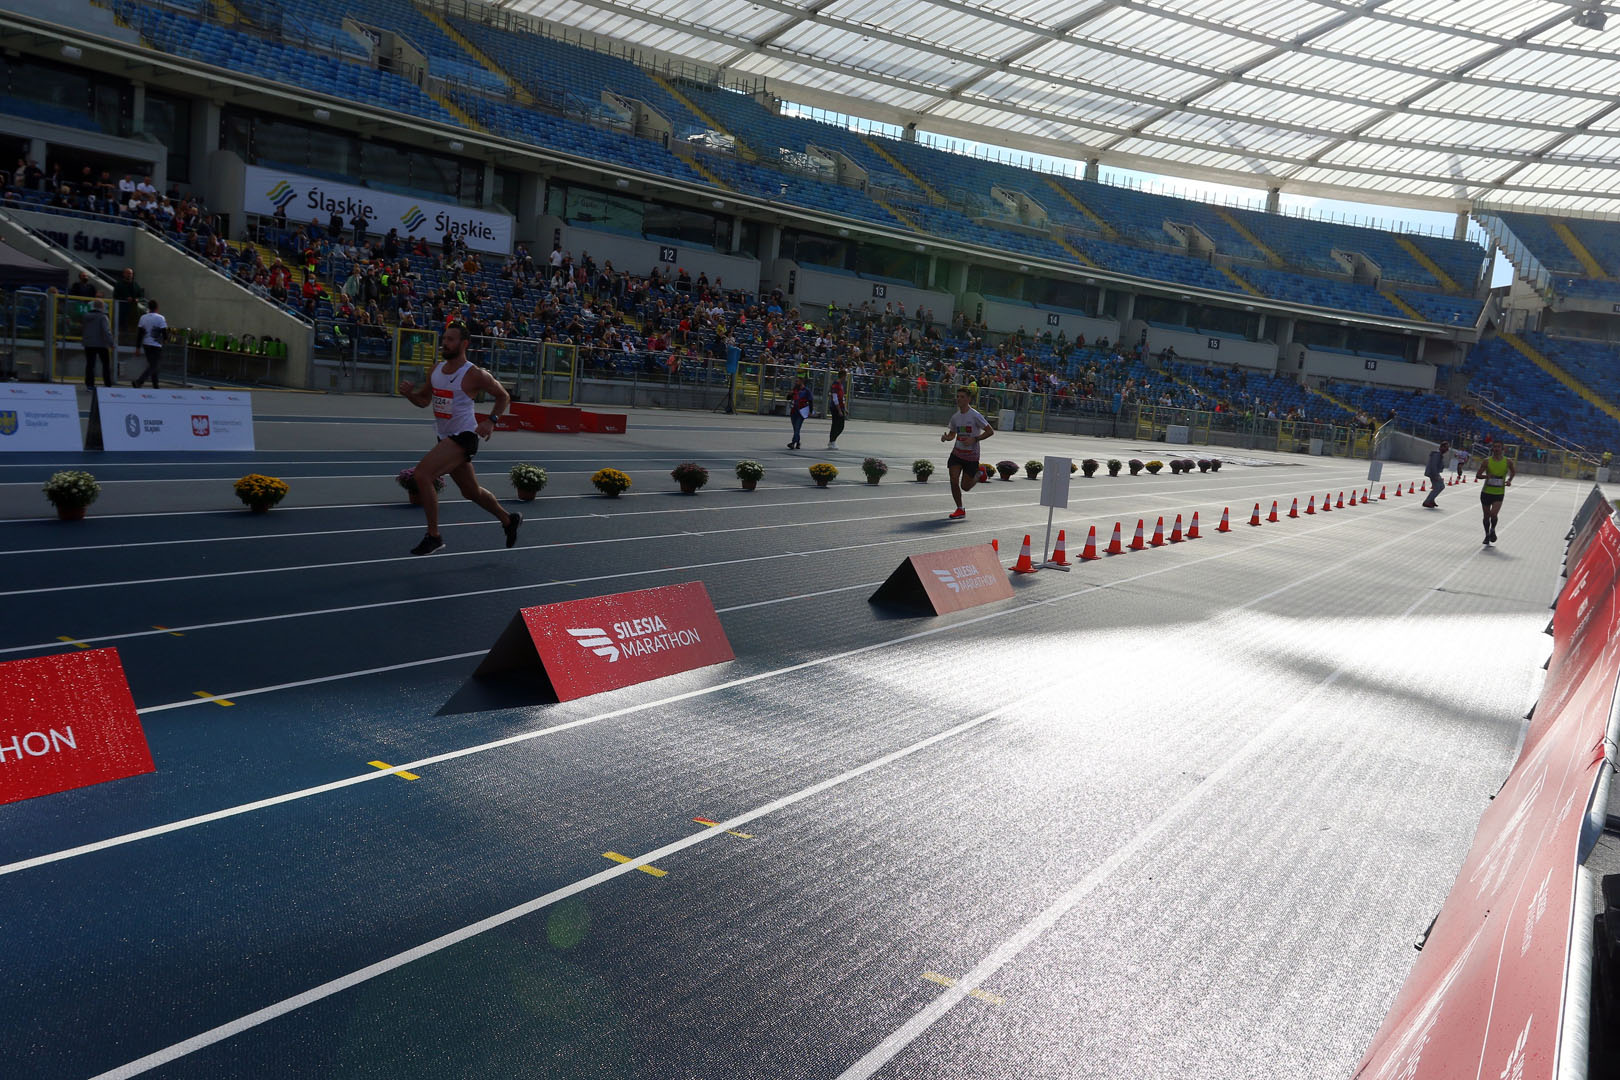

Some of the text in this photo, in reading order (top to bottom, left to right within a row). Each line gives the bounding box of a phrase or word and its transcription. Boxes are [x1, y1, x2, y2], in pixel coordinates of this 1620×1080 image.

[663, 248, 674, 261] 12
[953, 564, 979, 579] SILESIA
[958, 574, 997, 592] MARATHON
[613, 615, 667, 640] SILESIA
[619, 627, 702, 660] MARATHON
